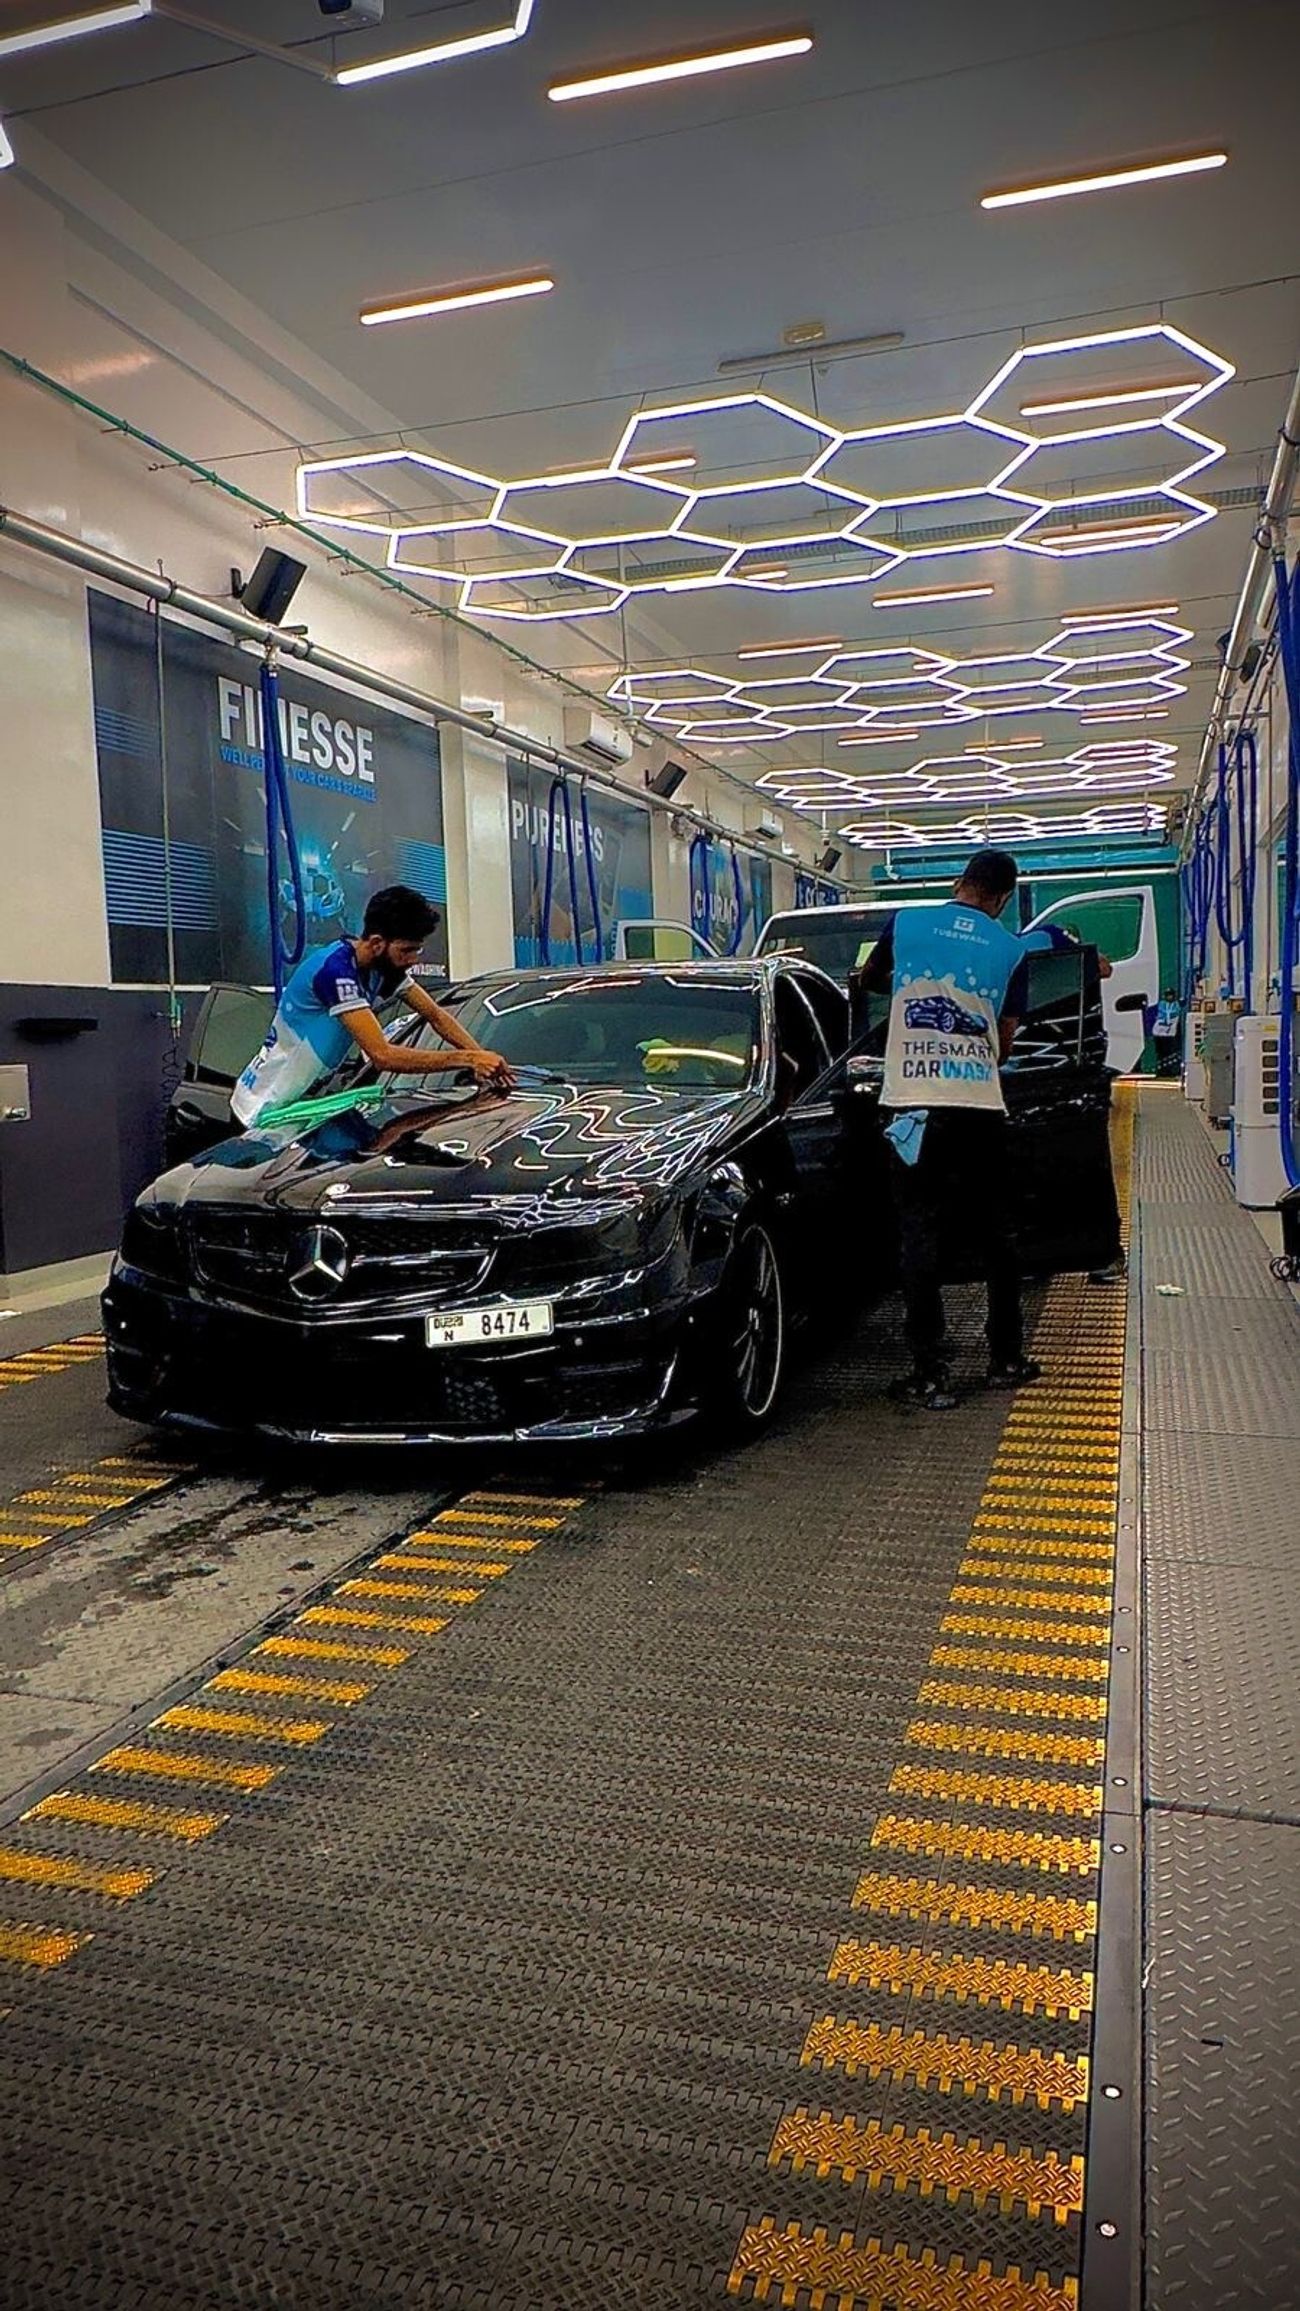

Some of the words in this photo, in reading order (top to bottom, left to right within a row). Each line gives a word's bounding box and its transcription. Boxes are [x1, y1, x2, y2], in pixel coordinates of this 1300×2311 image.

[902, 1041, 936, 1055] THE
[939, 1041, 993, 1059] SMART
[481, 1310, 530, 1336] 8474
[444, 1331, 454, 1342] N
